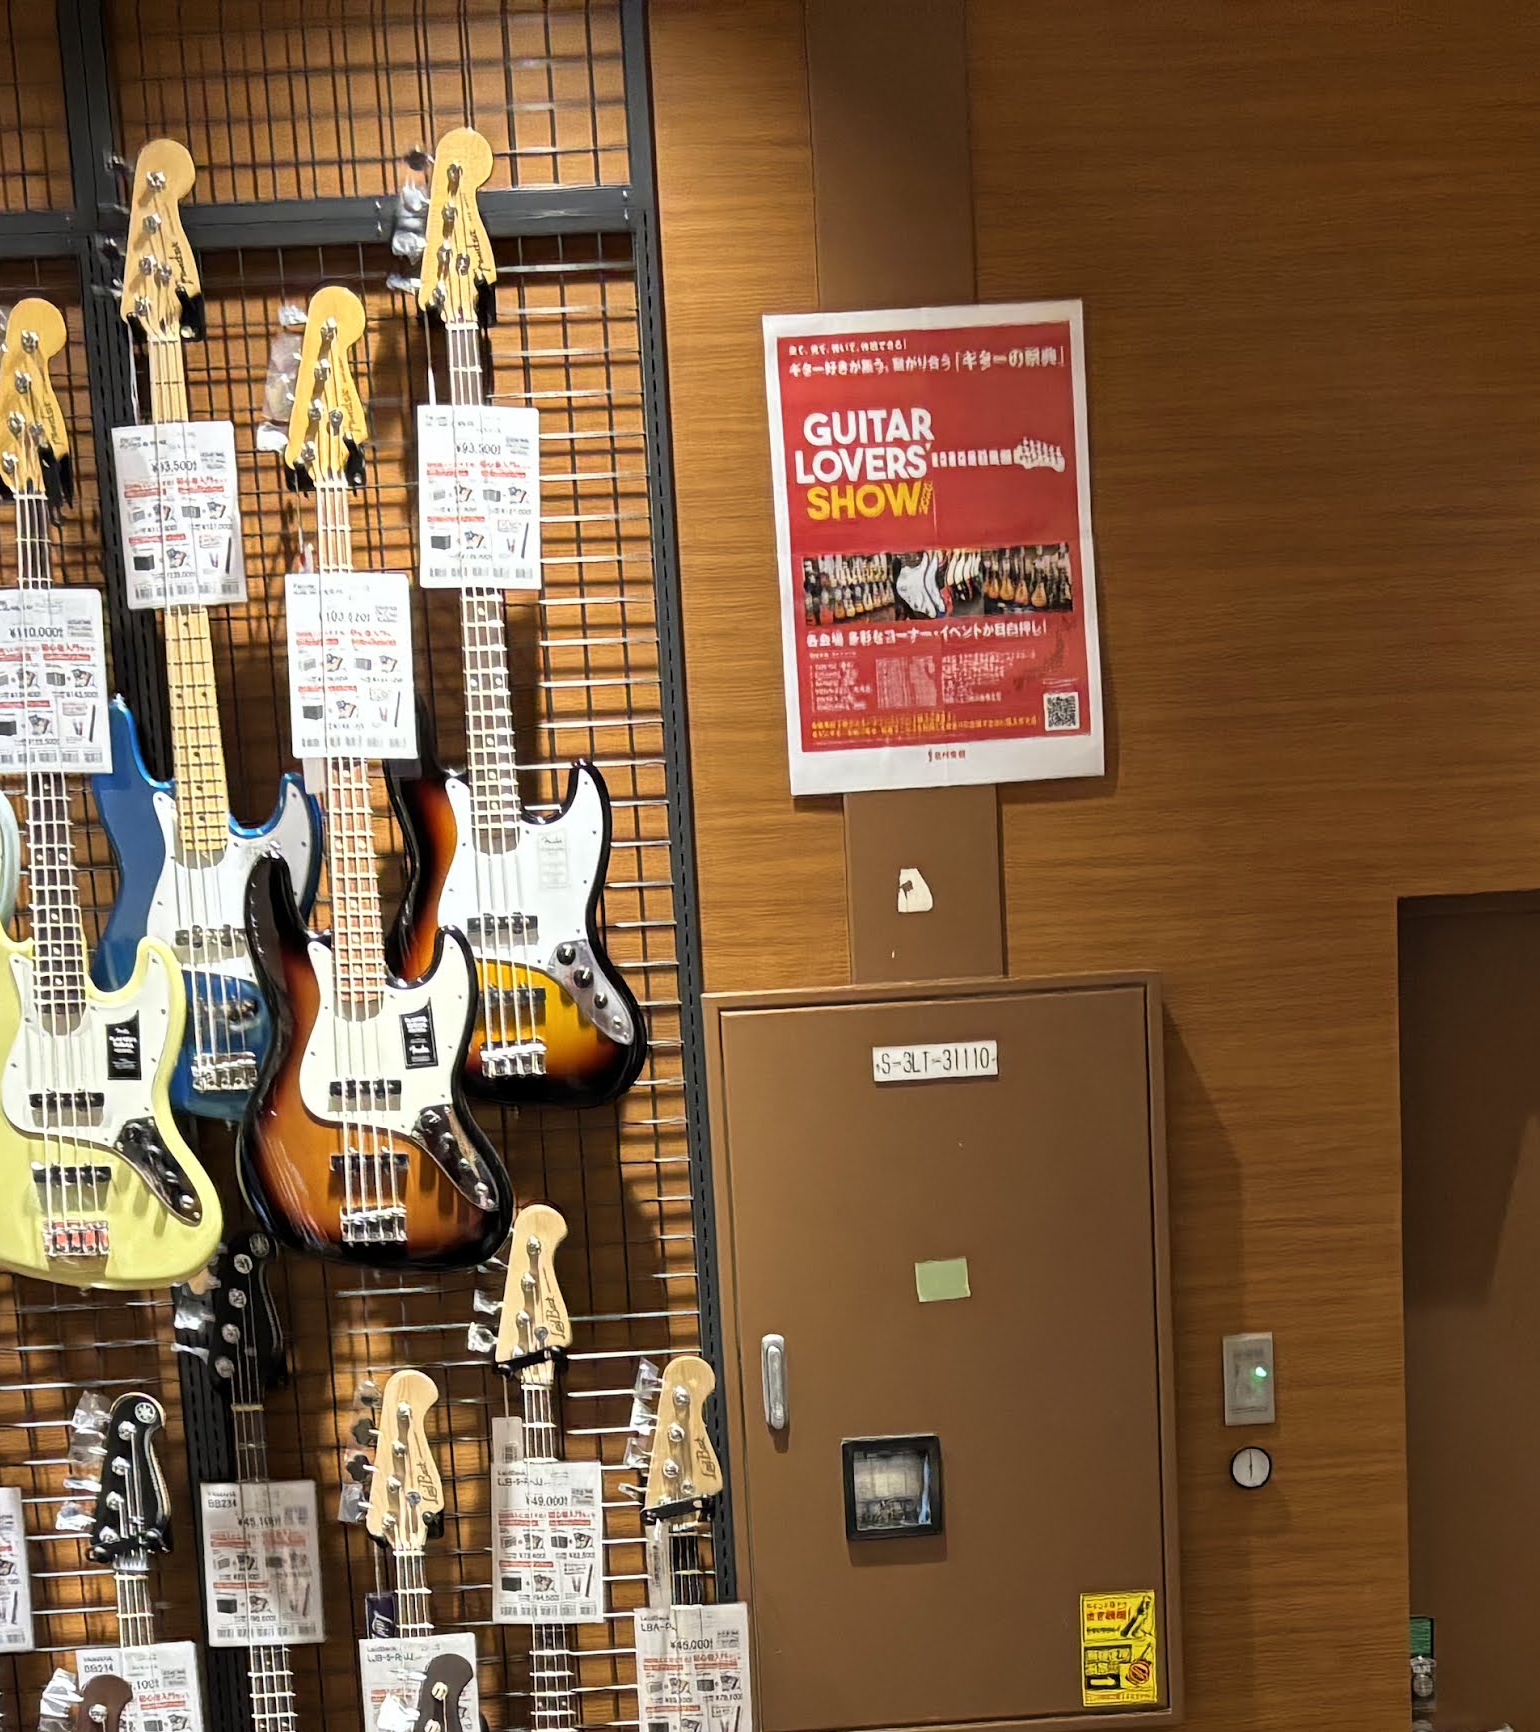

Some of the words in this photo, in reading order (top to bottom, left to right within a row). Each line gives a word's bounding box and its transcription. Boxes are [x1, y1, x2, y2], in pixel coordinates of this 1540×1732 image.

[803, 407, 936, 447] GUITAR
[794, 442, 932, 485] LOVERS'
[806, 480, 922, 521] SHOW
